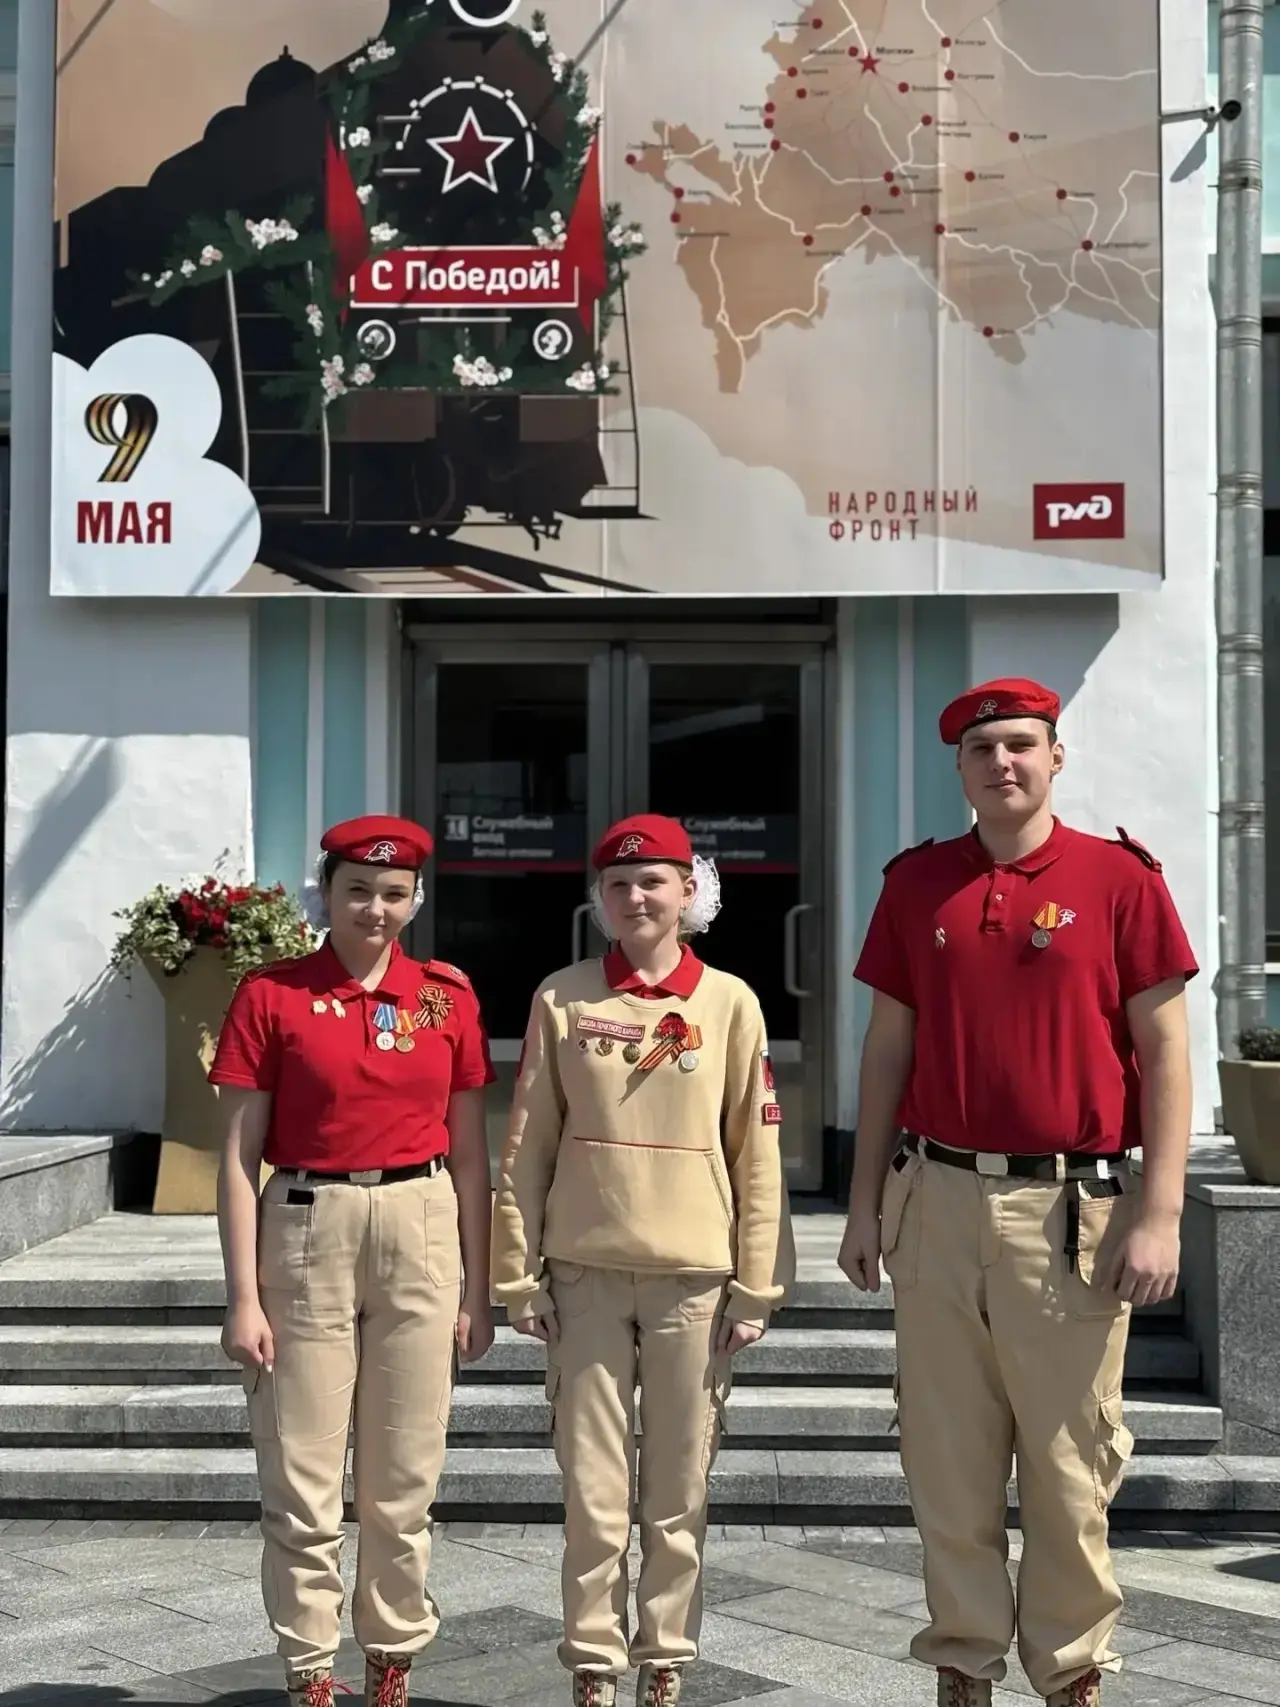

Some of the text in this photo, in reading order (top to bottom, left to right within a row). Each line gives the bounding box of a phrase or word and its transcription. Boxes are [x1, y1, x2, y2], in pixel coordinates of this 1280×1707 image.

[370, 258, 561, 296] С Победой!
[84, 392, 159, 483] 9
[828, 486, 979, 513] НАРОДНЫЙ
[76, 500, 173, 544] МАЯ
[828, 518, 921, 541] ФРОНТ
